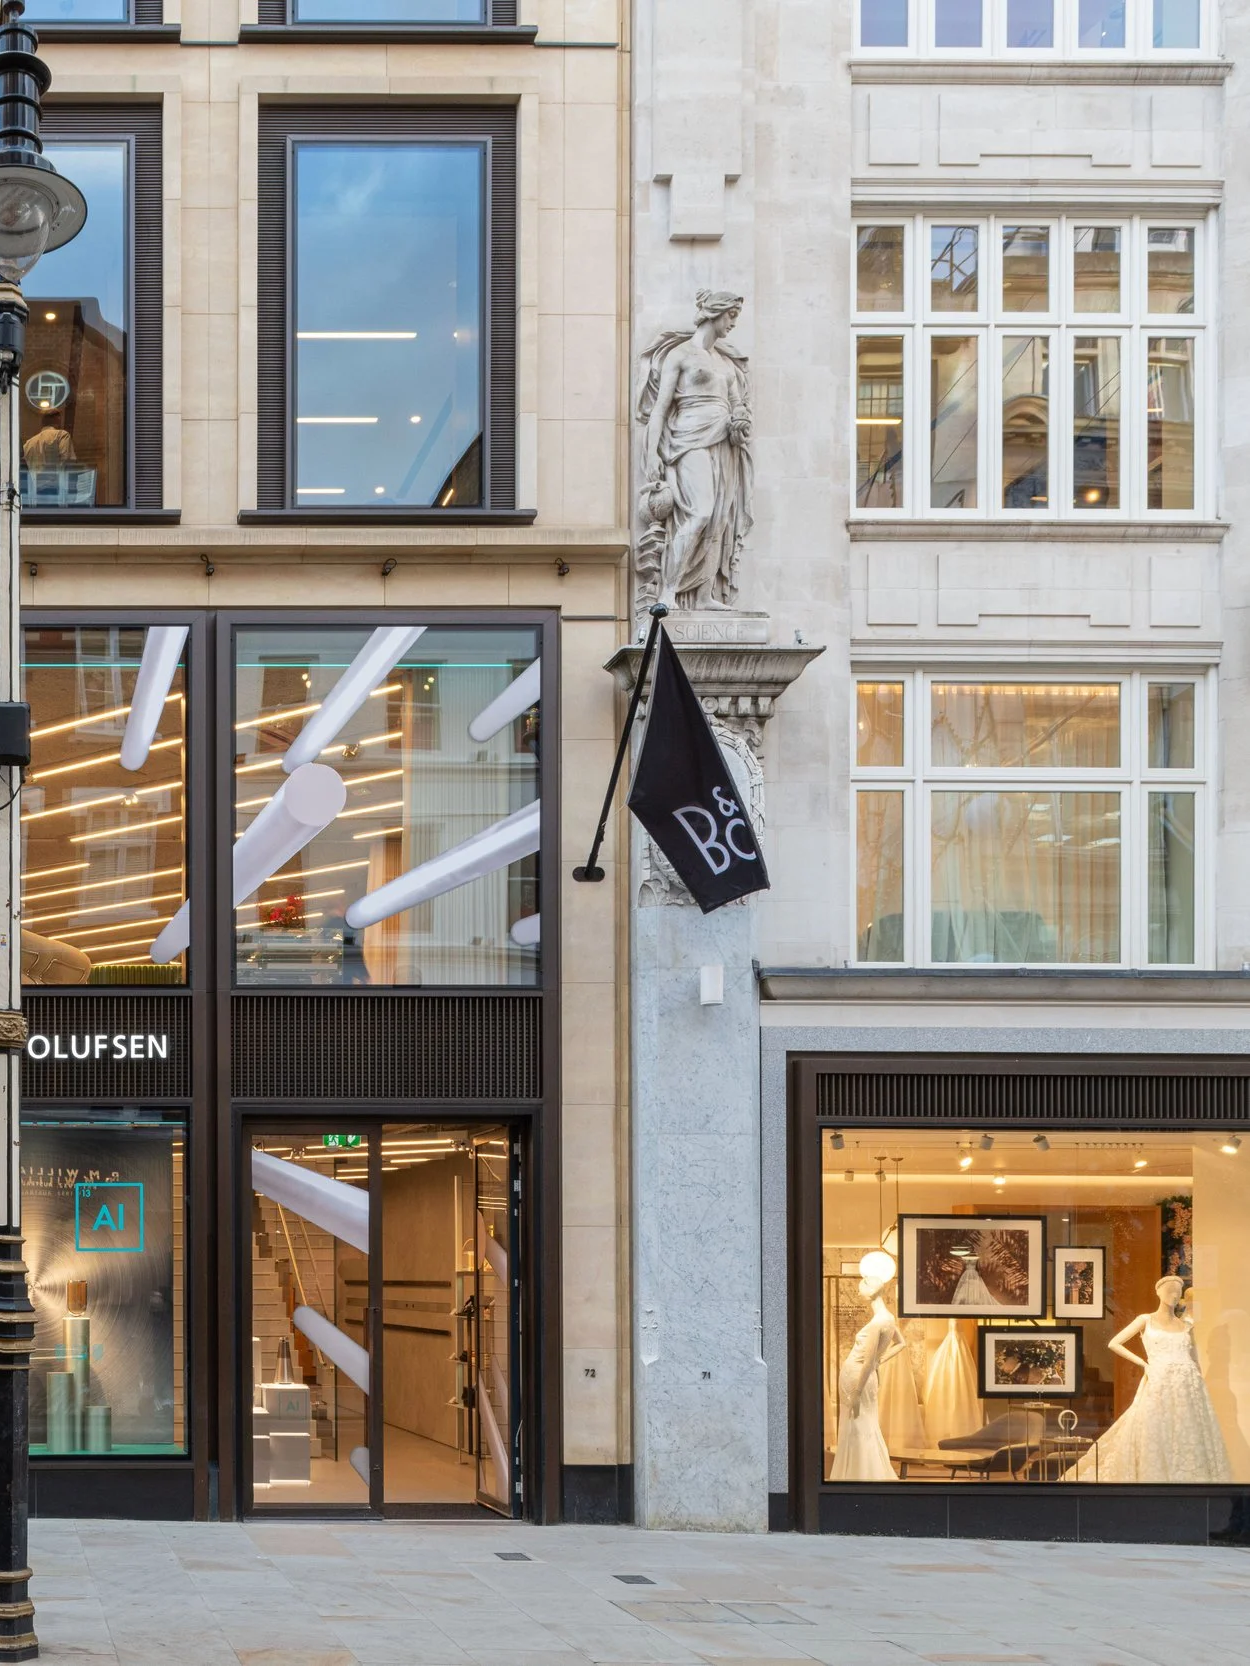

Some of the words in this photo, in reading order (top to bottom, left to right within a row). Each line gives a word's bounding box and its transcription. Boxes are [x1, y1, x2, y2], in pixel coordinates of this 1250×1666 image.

[674, 624, 749, 641] SCIENCE
[27, 1034, 168, 1059] OLUFSEN
[81, 1189, 91, 1198] 13
[584, 1368, 596, 1378] 72
[701, 1371, 711, 1380] 71
